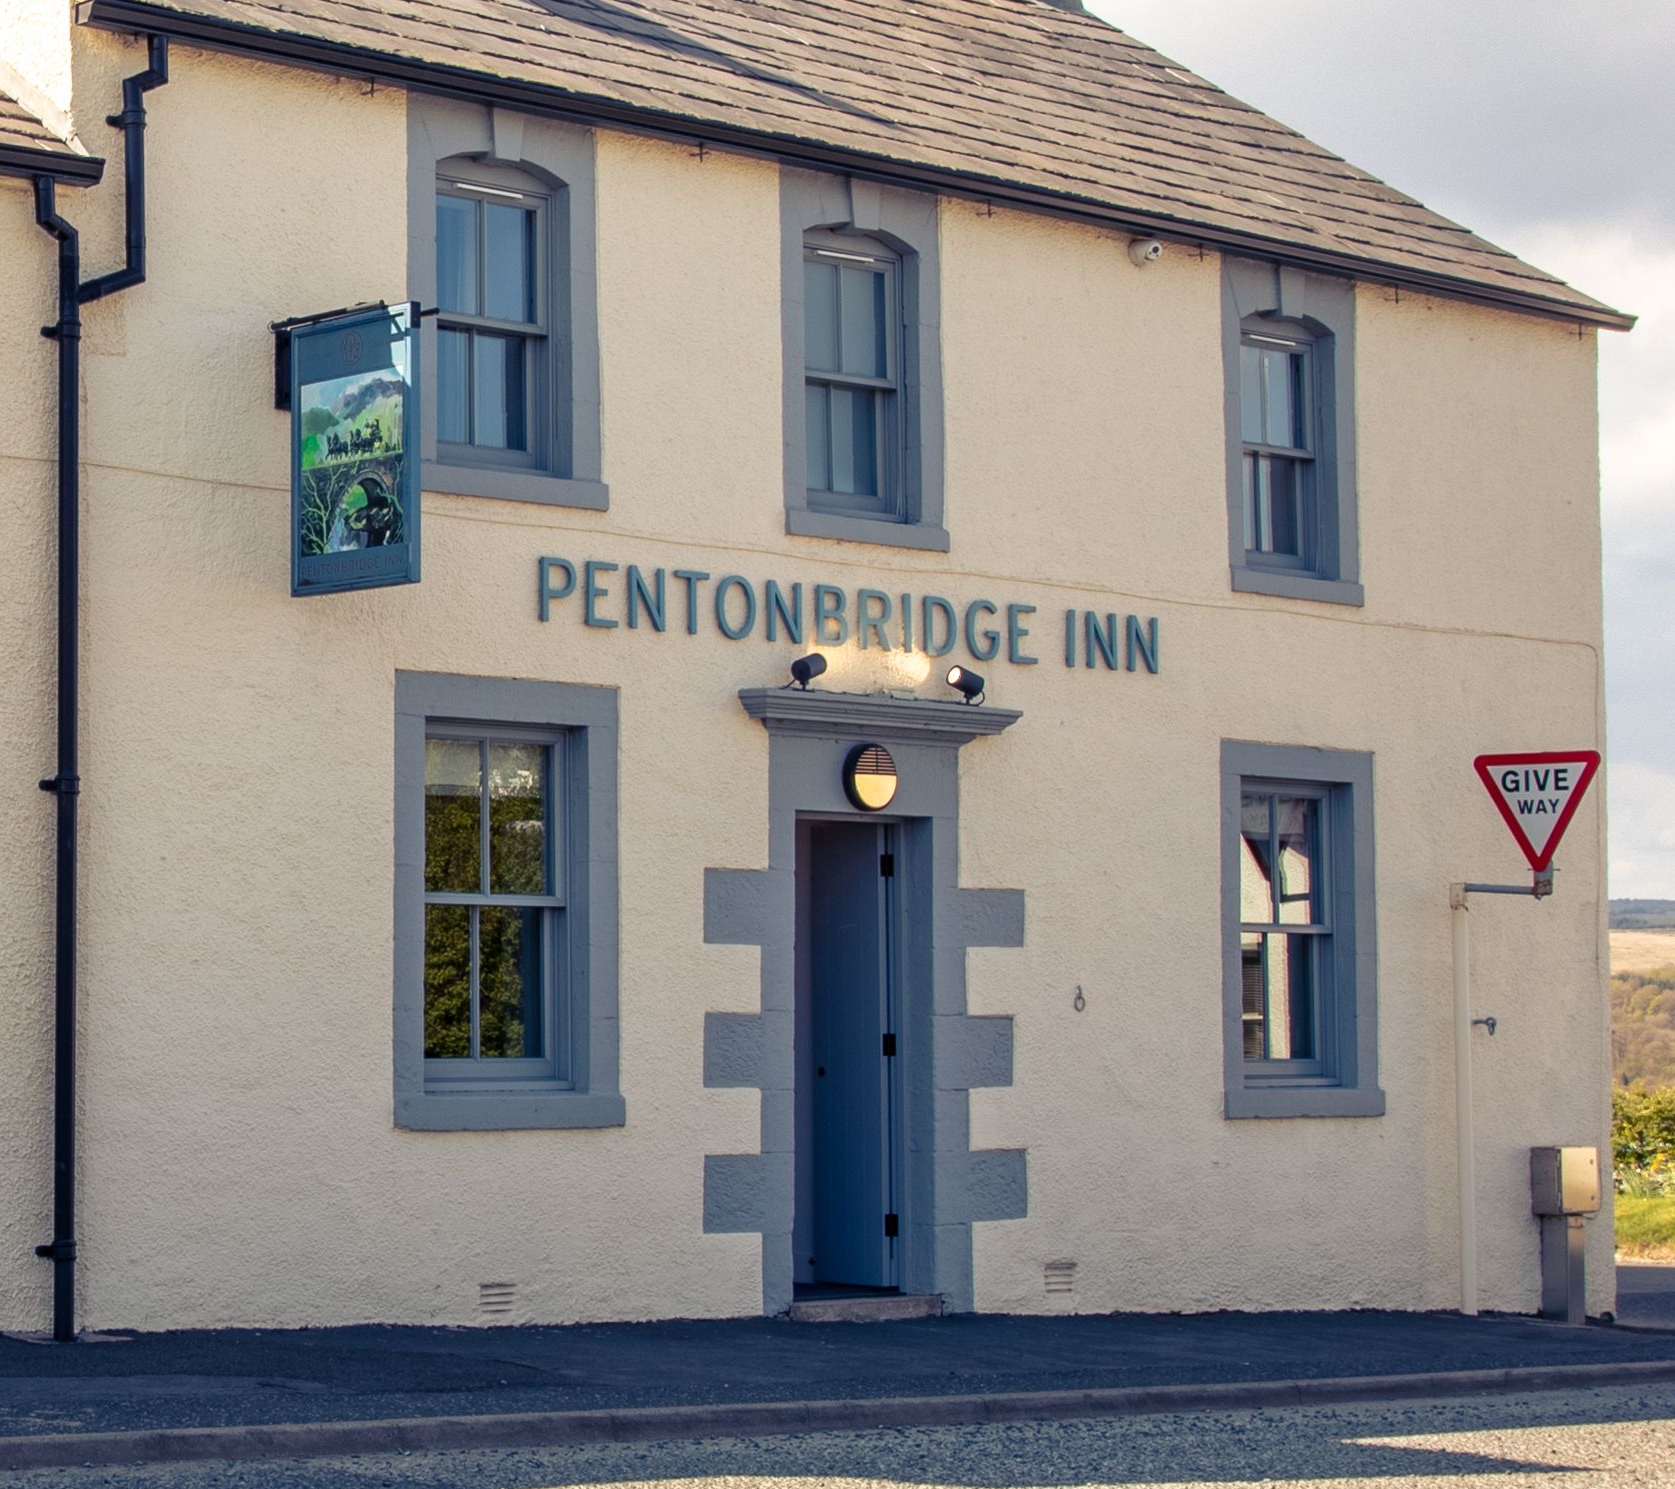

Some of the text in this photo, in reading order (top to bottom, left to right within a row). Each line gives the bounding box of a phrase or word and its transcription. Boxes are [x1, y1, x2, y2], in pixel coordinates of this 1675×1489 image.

[384, 552, 403, 568] INN
[537, 555, 1159, 674] PENTONBRIDGE INN
[1501, 768, 1569, 793] GIVE
[1517, 798, 1559, 815] WAY
